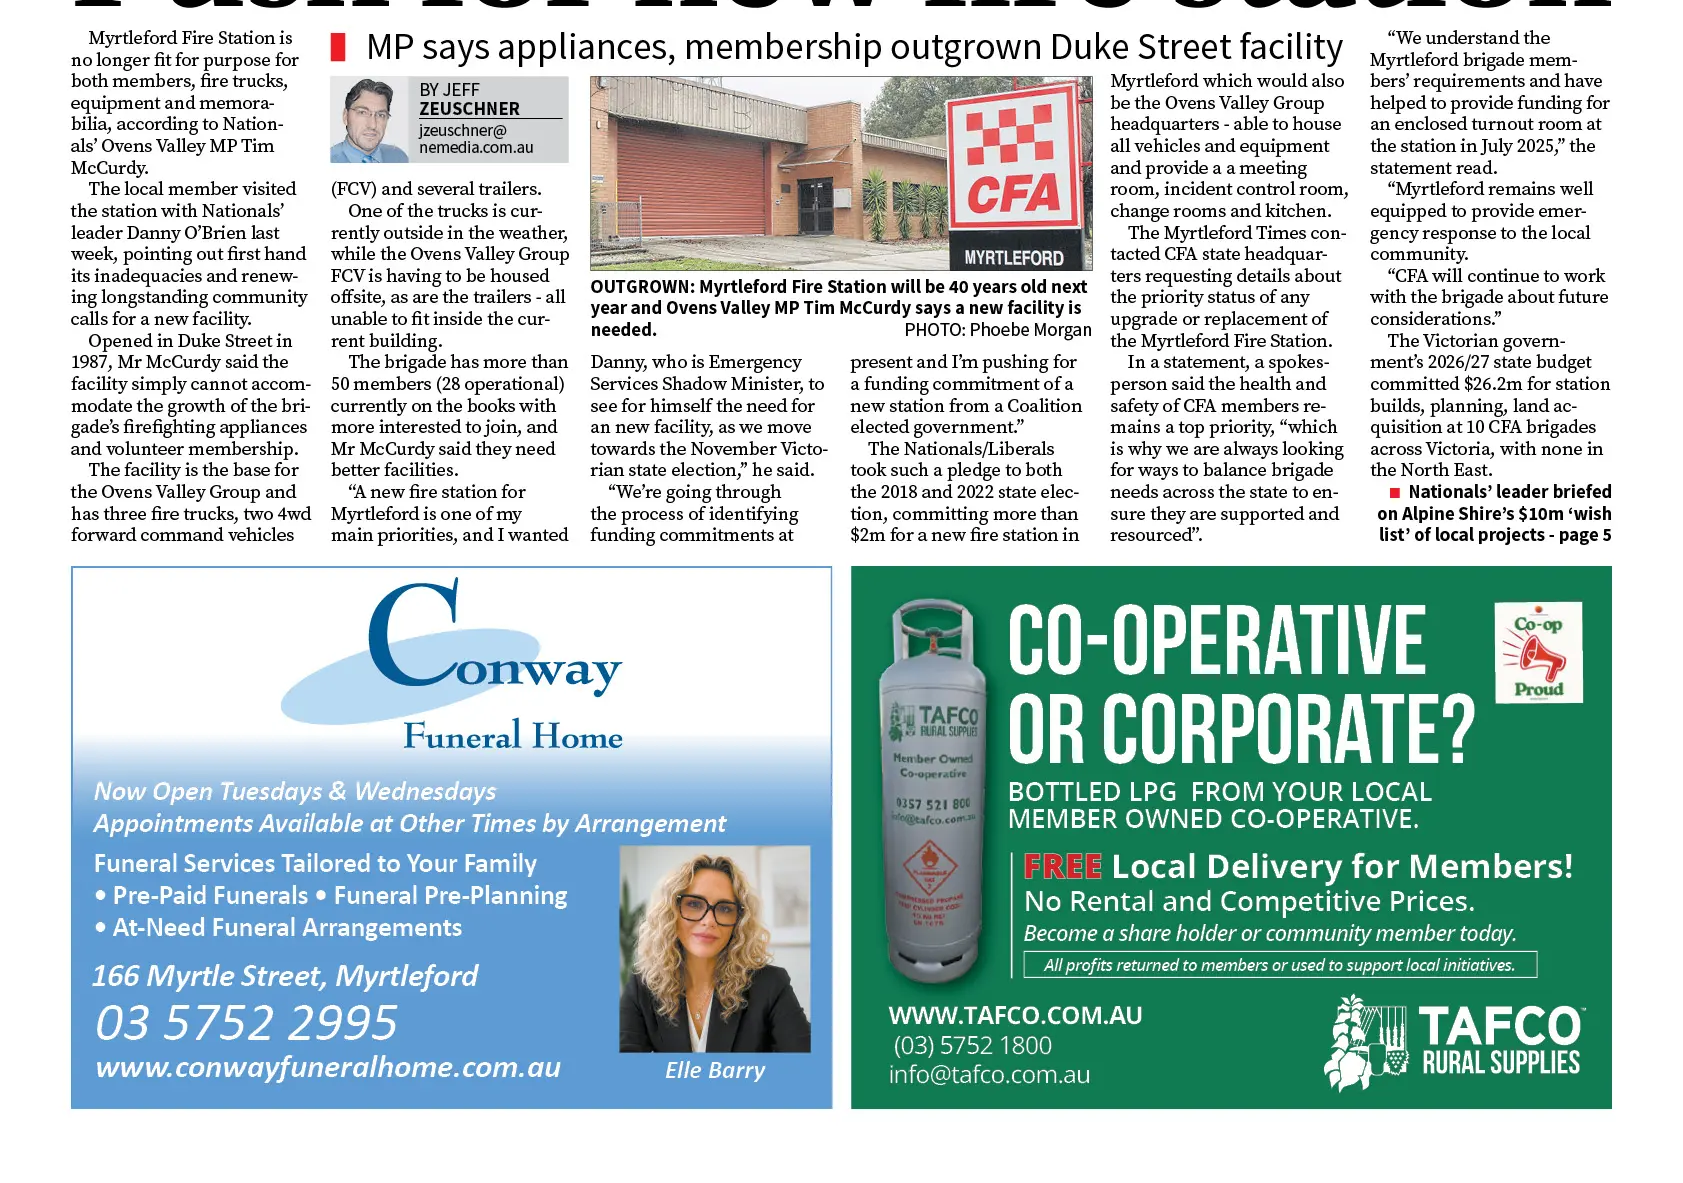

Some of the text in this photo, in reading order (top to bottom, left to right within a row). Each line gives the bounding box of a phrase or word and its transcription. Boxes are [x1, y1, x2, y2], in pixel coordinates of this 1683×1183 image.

[89, 30, 292, 48] Myrtleford Fire Station is
[369, 32, 1343, 67] MP says appliances, membership outgrown Duke Street facility
[421, 83, 480, 96] BY JEFF
[1111, 73, 1344, 91] Myrtleford which would also
[420, 102, 519, 115] ZEUSCHNER
[419, 124, 506, 139] jzeuschner@
[420, 141, 533, 153] nemedia.com.au
[332, 181, 541, 198] (FCV) and several trailers.
[969, 174, 1059, 213] CFA
[1388, 181, 1593, 199] “Myrtleford remains well
[965, 250, 1064, 266] MYRTLEFORD
[591, 279, 1087, 297] OUTGROWN: Myrtleford Fire Station will be 40 years old next
[591, 354, 802, 373] Danny, who is Emergency
[1370, 354, 1592, 373] ment’s 2026/27 state budget
[868, 441, 1054, 458] The Nationals/Liberals
[1410, 484, 1611, 498] Nationals’ leader briefed
[1111, 527, 1202, 541] resourced”.
[1511, 617, 1562, 634] Co-op
[369, 577, 622, 697] Conway
[1010, 604, 1425, 675] CO-OPERATIVE
[1515, 683, 1564, 695] Proud
[919, 706, 978, 726] TAFCO
[404, 718, 622, 748] Funeral Home
[921, 726, 978, 737] RURAL SUPPLIES
[1010, 693, 1474, 764] OR CORPORATE?
[893, 753, 973, 764] Member Owned
[900, 769, 967, 781] Co-operative
[896, 798, 970, 810] 0357 521 800
[1026, 853, 1571, 886] FREE Local Delivery for Members!
[93, 964, 479, 992] 166 Myrtle Street, Myrtleford
[97, 1005, 397, 1040] 03 5752 2995
[889, 1006, 1141, 1024] WWW.TAFCO.COM.AU
[1419, 1006, 1580, 1045] TAFCO
[895, 1036, 1051, 1058] (03) 5752 1800
[97, 1055, 560, 1083] www.conwayfuneralhome.com.au
[1424, 1050, 1579, 1073] RURAL SUPPLIES
[666, 1061, 765, 1082] Elle Barry
[891, 1064, 1089, 1085] info@tafco.com.au
